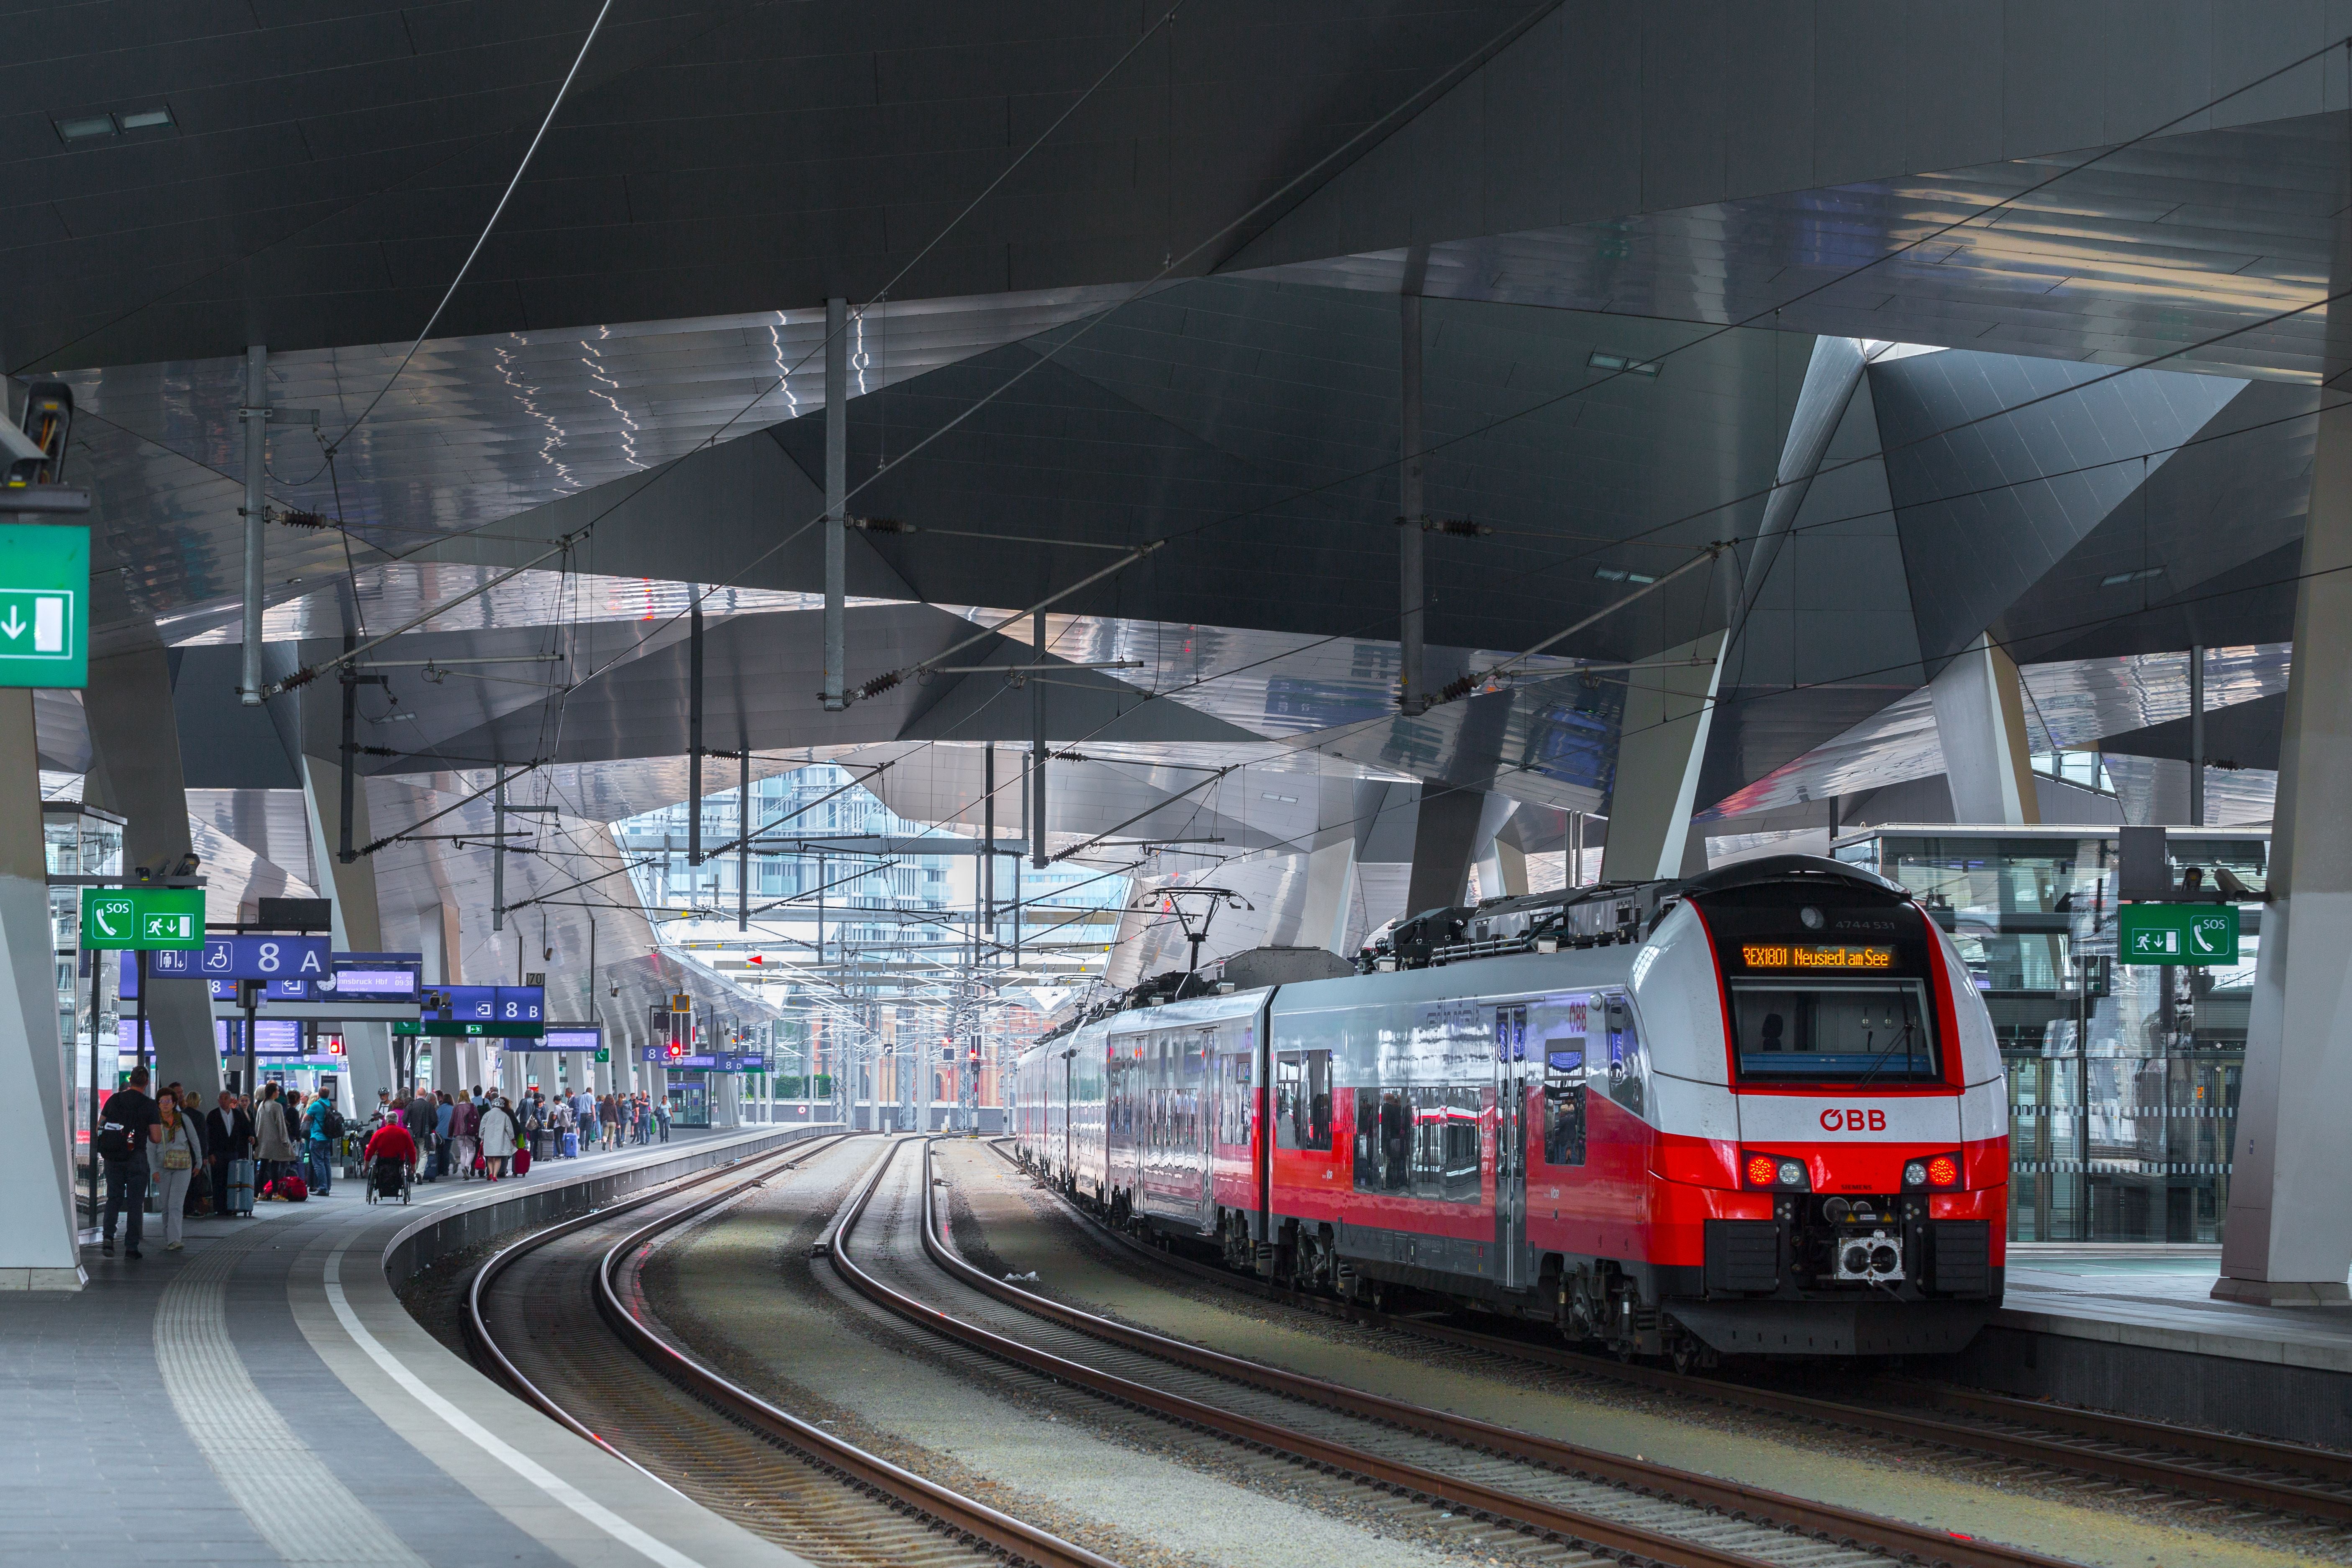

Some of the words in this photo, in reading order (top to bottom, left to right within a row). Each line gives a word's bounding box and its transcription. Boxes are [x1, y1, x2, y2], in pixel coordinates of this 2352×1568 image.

[106, 903, 129, 913] SOS
[2203, 919, 2225, 929] SOS
[258, 943, 280, 972] 8
[300, 950, 321, 972] A
[1795, 948, 1846, 965] Neusiedl
[1848, 954, 1863, 965] am
[1865, 949, 1888, 965] See
[529, 974, 541, 984] 70
[212, 980, 221, 993] 8
[506, 1002, 518, 1018] 8
[529, 1006, 538, 1018] B
[1570, 1001, 1586, 1033] ÖBB
[649, 1049, 656, 1059] 8
[1820, 1109, 1886, 1131] ÖBB
